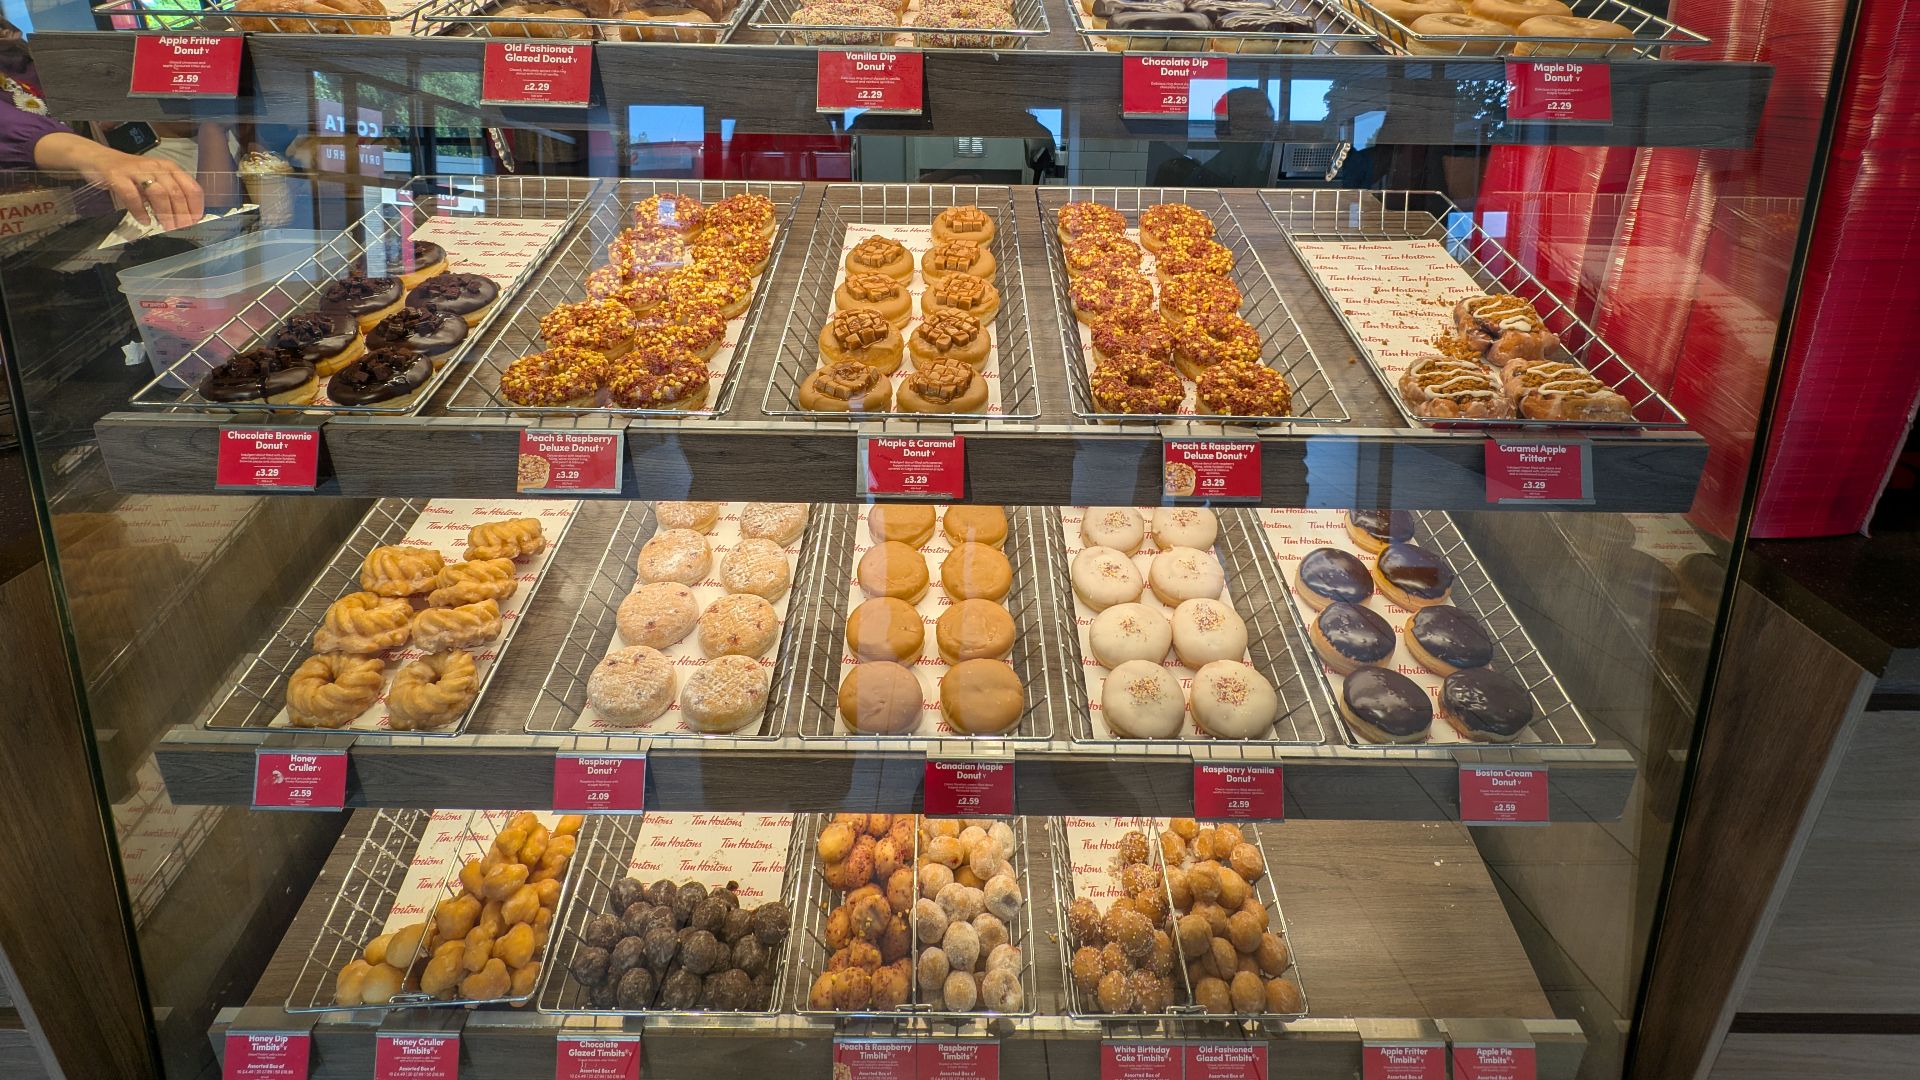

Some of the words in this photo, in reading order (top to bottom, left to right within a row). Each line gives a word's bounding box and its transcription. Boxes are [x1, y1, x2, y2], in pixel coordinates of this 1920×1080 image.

[159, 37, 188, 46] Apple
[190, 37, 220, 45] Fritter
[174, 46, 203, 54] Donut
[524, 44, 574, 53] Fashioned
[505, 54, 539, 63] Glazed
[543, 55, 572, 63] Donut
[846, 52, 877, 60] Vanilla
[880, 53, 896, 63] Dip
[857, 62, 885, 70] Donut
[1142, 57, 1190, 66] Chocolate
[1192, 58, 1208, 68] Dip
[1161, 68, 1189, 76] Donut
[1534, 64, 1564, 73] Maple
[1567, 64, 1582, 73] Dip
[1545, 73, 1573, 81] Donut
[525, 83, 549, 91] £2.29
[1163, 96, 1187, 104] £2.29
[228, 431, 273, 440] Chocolate
[276, 432, 312, 440] Brownie
[527, 434, 554, 442] Peach
[557, 434, 563, 442] &
[566, 434, 612, 445] Raspberry
[256, 441, 283, 449] Donut
[572, 444, 599, 452] Donut
[878, 439, 906, 449] Maple
[917, 440, 955, 448] Caramel
[1209, 442, 1254, 452] Raspberry
[904, 449, 930, 457] Donut
[1540, 445, 1566, 455] Apple
[1216, 452, 1242, 460] Donut
[1520, 454, 1547, 462] Fritter
[556, 471, 579, 479] £3.29
[488, 508, 522, 516] Hortons
[291, 755, 316, 764] Honey
[579, 758, 622, 767] Raspberry
[936, 762, 975, 770] Canadian
[977, 763, 1003, 772] Maple
[1203, 766, 1245, 775] Raspberry
[1247, 766, 1274, 774] Vanilla
[1492, 778, 1516, 786] Donut
[691, 815, 707, 825] Tim
[708, 816, 742, 826] Hortons
[760, 817, 776, 826] Tim
[651, 837, 666, 847] Tim
[667, 836, 702, 847] Hortons
[721, 838, 736, 848] Tim
[738, 838, 772, 849] Hortons
[1082, 839, 1098, 849] Tim
[680, 860, 696, 871] Tim
[697, 860, 732, 871] Hortons
[752, 861, 767, 872] Tim
[393, 1039, 417, 1047] Honey
[872, 1044, 912, 1052] Raspberry
[939, 1044, 977, 1053] Raspberry
[1138, 1046, 1170, 1055] Birthday
[1381, 1048, 1403, 1056] Apple
[1477, 1048, 1498, 1056] Apple
